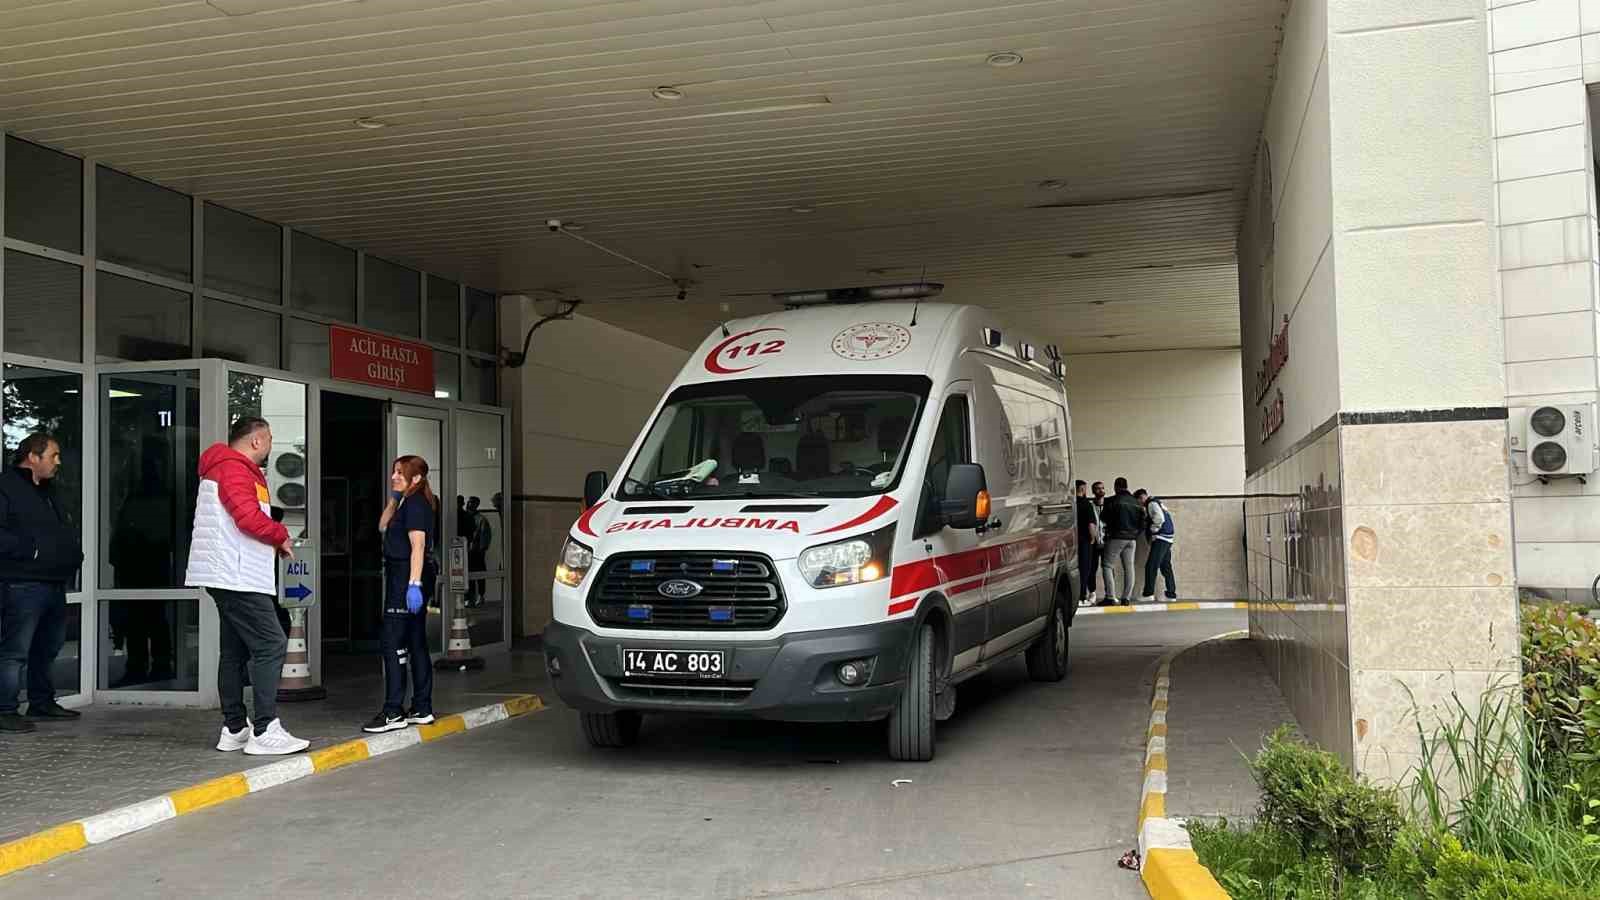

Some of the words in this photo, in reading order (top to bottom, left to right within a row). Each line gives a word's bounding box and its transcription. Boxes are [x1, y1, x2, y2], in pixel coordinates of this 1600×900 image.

[350, 337, 380, 357] ACİL
[382, 343, 419, 365] HASTA
[725, 340, 785, 359] 112
[367, 362, 405, 385] GİRİŞİ
[287, 559, 310, 576] ACİL
[665, 583, 691, 595] Ford
[628, 652, 646, 670] 14
[653, 652, 678, 671] AC
[688, 653, 721, 672] 803
